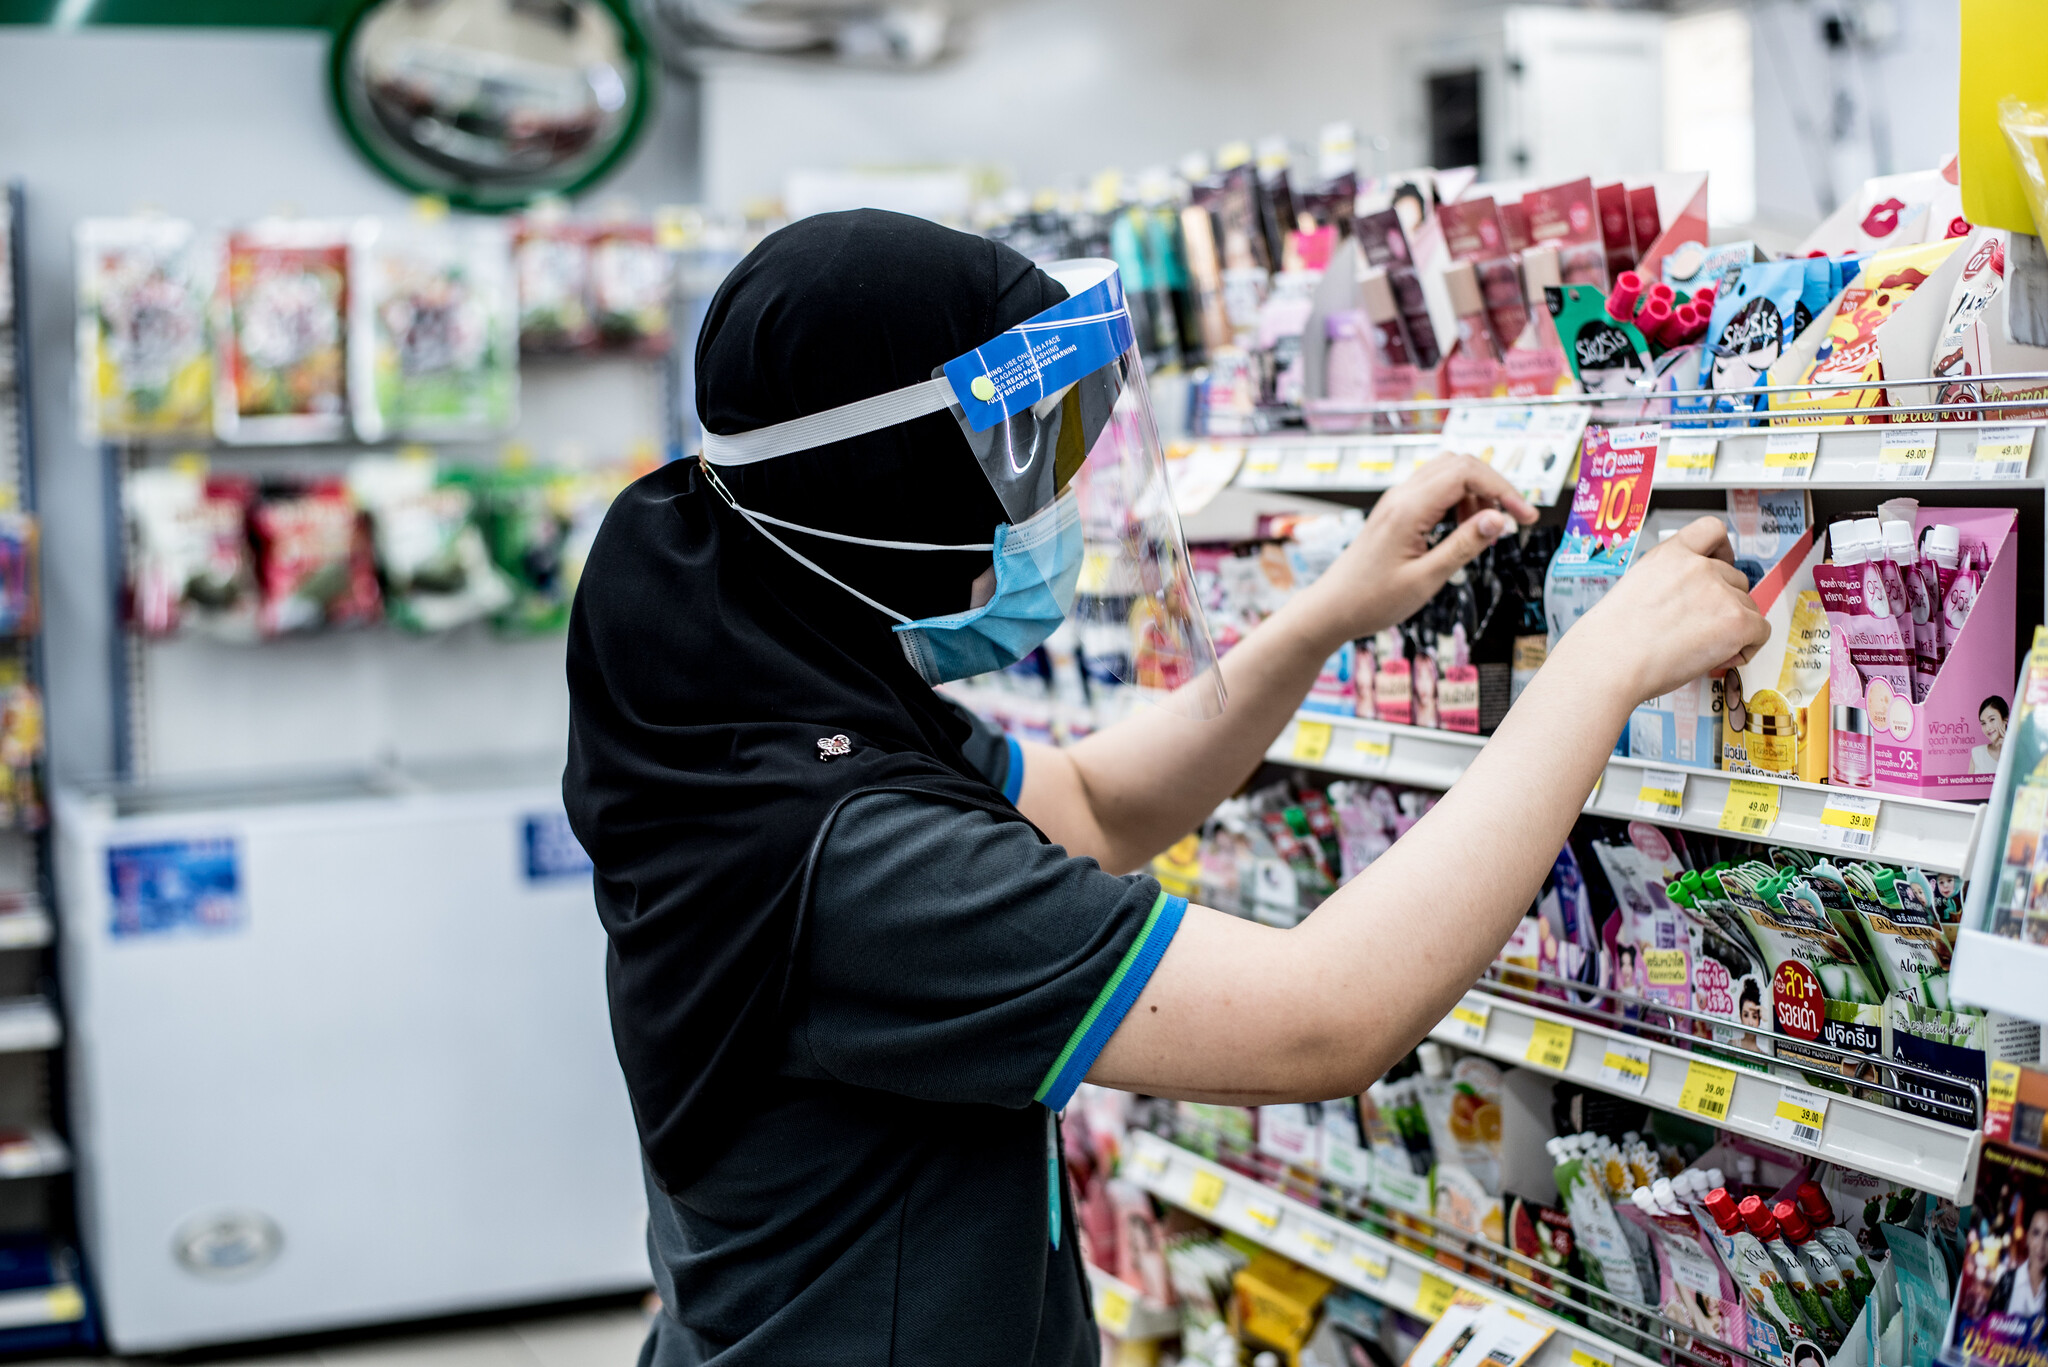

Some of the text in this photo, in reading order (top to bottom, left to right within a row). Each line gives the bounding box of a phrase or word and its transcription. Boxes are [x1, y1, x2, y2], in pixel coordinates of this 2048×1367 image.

[1003, 358, 1018, 370] USE
[1032, 345, 1042, 354] AS
[1045, 335, 1061, 347] FACE
[1000, 363, 1026, 381] AGAINST
[1006, 372, 1024, 386] READ
[1023, 357, 1052, 377] PACKAGE
[1050, 344, 1078, 361] WARNING
[1003, 378, 1030, 397] BEFORE
[1905, 449, 1927, 459] 49.00
[2001, 445, 2023, 455] 49.00
[1595, 479, 1632, 530] 10
[1629, 503, 1644, 514] บาท
[1928, 716, 1970, 735] ผิวคล้ำ
[1951, 735, 1976, 745] ฝ้าแดด
[1723, 744, 1748, 761] ผิวย่น
[1748, 801, 1769, 813] 49.00
[1849, 815, 1871, 827] 39.00
[1824, 1022, 1877, 1049] ฟูจิครีม
[1910, 1014, 1948, 1041] perfectly
[1949, 1017, 1976, 1037] skin!
[1705, 1083, 1725, 1095] 39.00
[1800, 1109, 1819, 1123] 39.00
